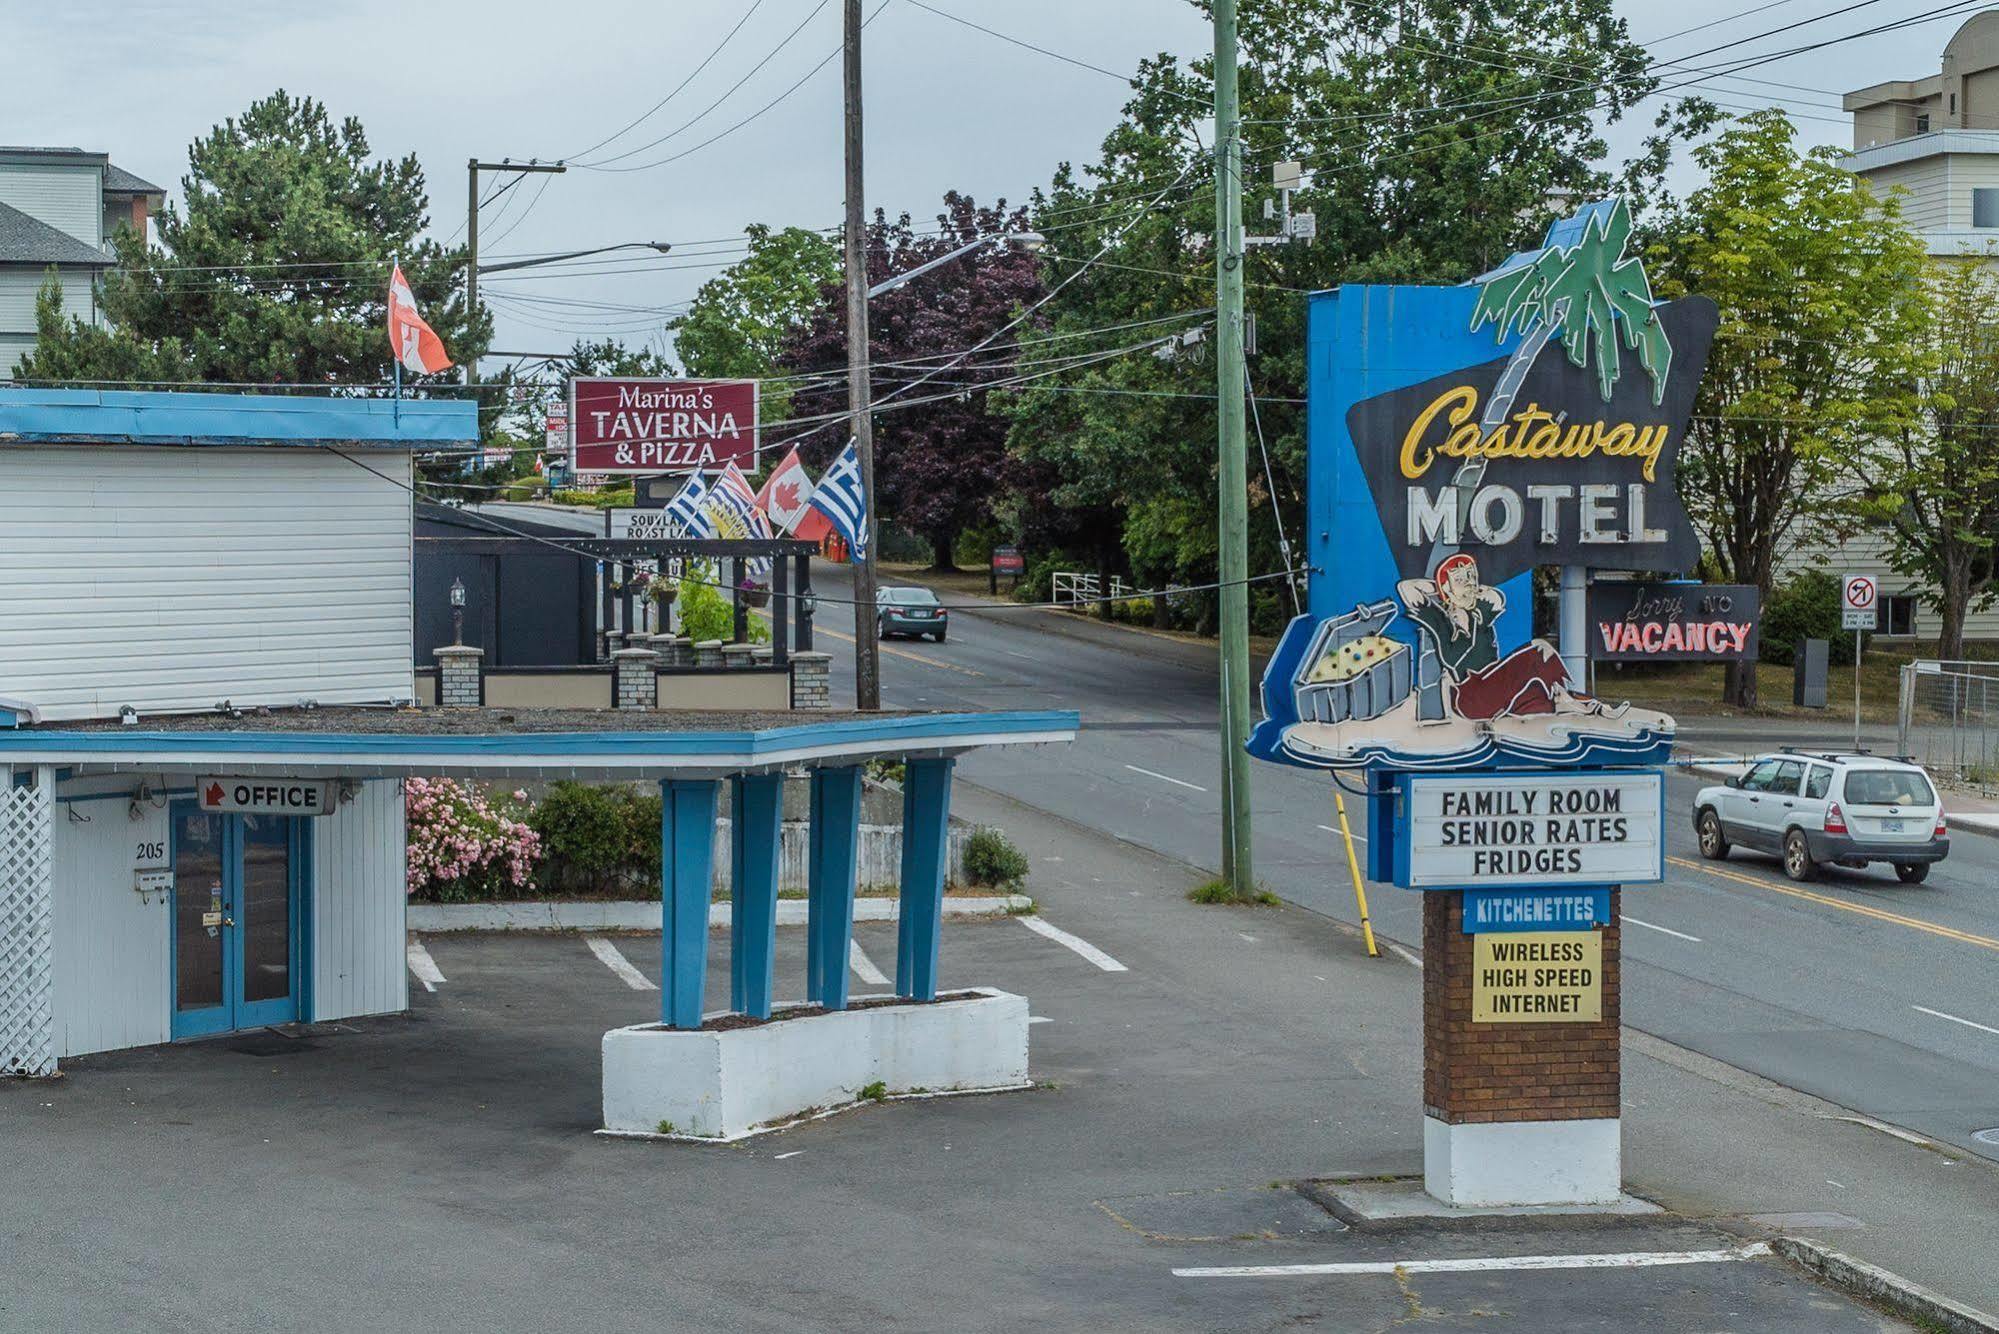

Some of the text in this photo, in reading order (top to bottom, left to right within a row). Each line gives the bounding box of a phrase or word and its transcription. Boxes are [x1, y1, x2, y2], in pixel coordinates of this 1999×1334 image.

[618, 385, 713, 410] Marina's
[590, 411, 741, 440] TAVERNA
[1400, 386, 1669, 483] Castaway
[615, 442, 636, 465] &
[631, 514, 680, 527] SOUVLA
[1406, 484, 1669, 547] MOTEL
[627, 527, 693, 539] ROAST LAM
[1600, 621, 1752, 654] VACANCY
[234, 786, 317, 807] OFFICE
[1442, 788, 1621, 816] FAMILY ROOM
[1442, 818, 1627, 845] SENIOR RATES
[136, 842, 164, 860] 205
[1474, 848, 1581, 874] FRIDGES
[1477, 896, 1594, 922] KITCHENETTES
[1492, 942, 1583, 961] WIRELESS
[1482, 968, 1592, 987] HIGH SPEED
[1492, 994, 1581, 1013] INTERNET
